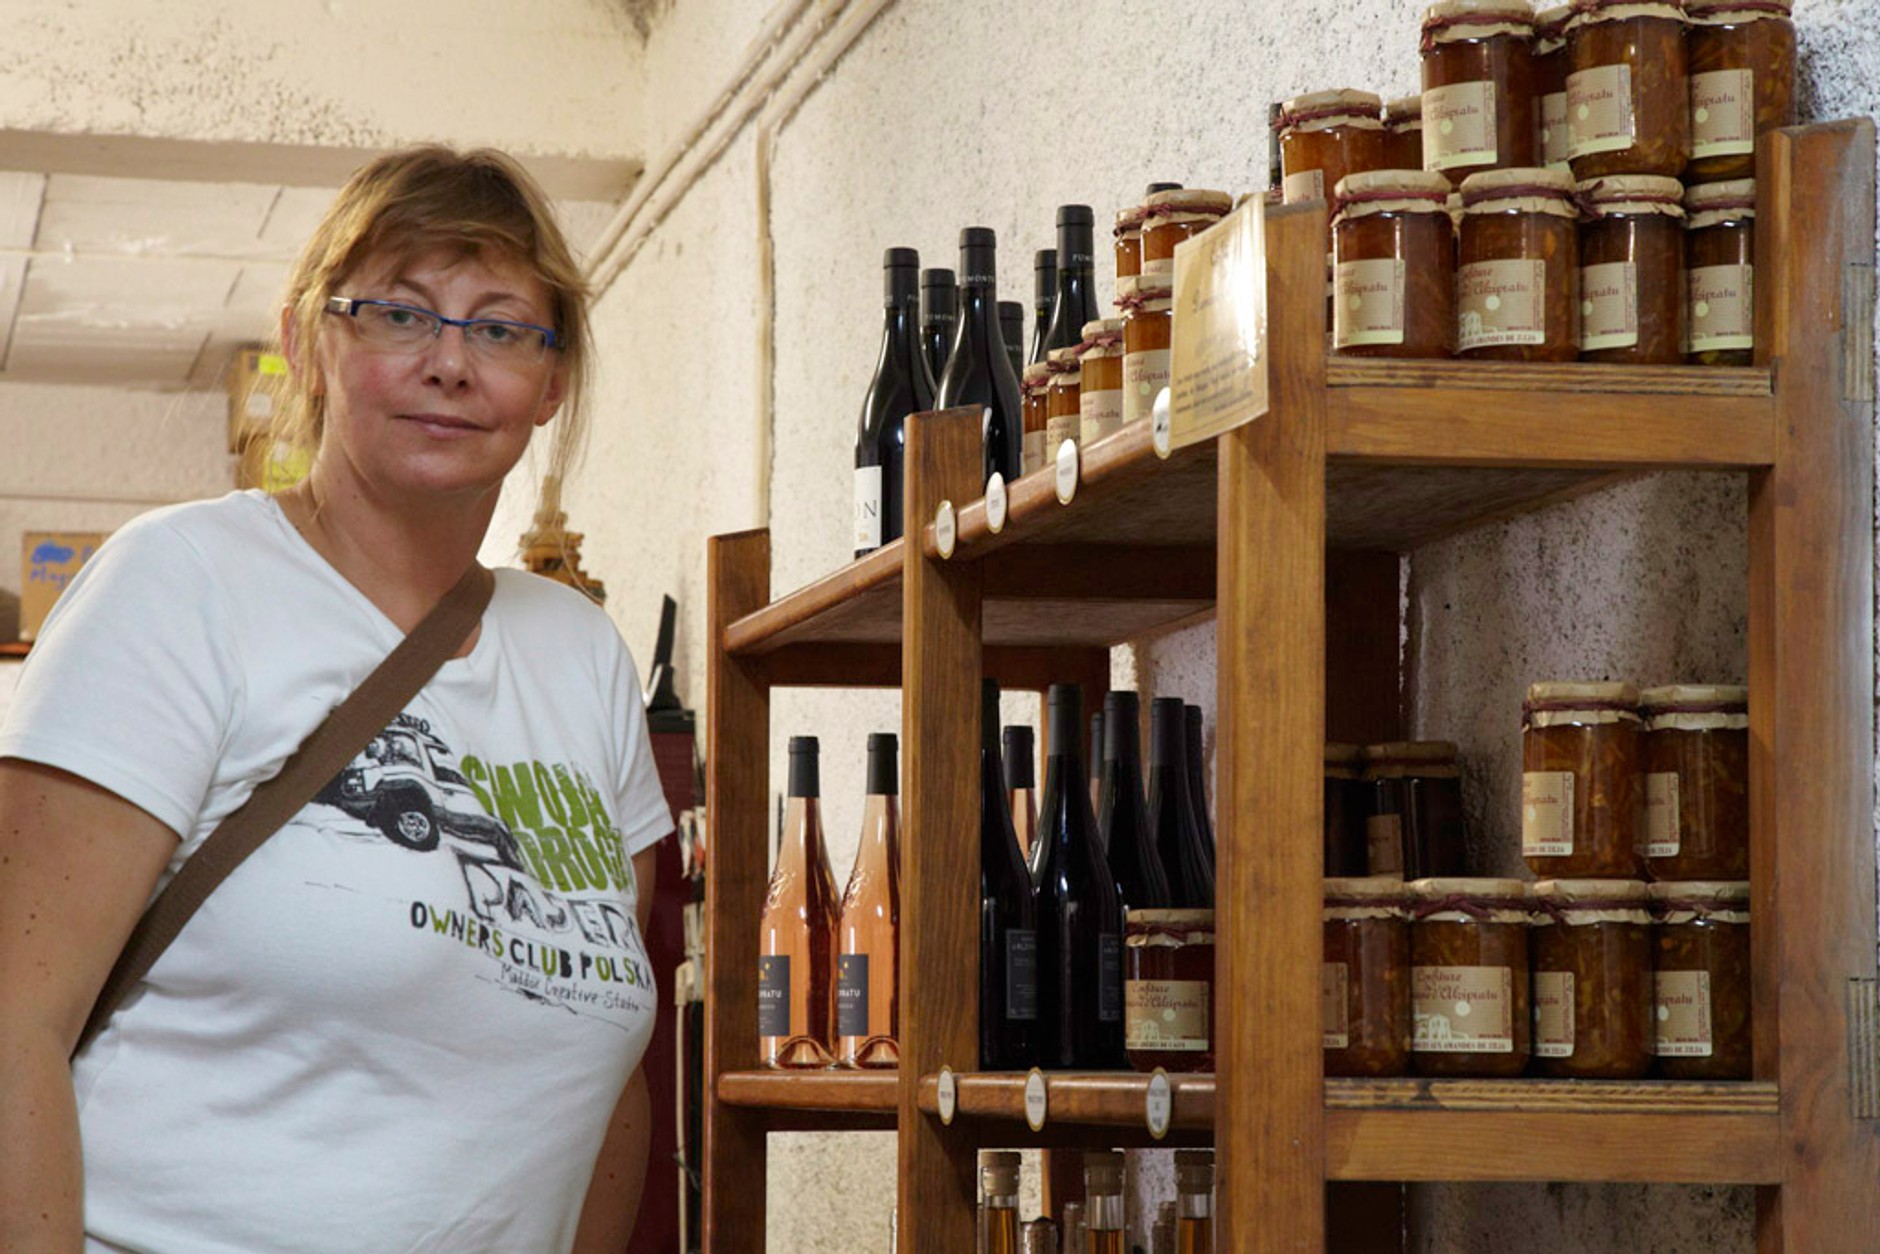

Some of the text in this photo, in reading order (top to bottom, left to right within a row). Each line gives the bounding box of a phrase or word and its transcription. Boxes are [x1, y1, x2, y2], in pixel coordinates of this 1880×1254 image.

[411, 901, 653, 993] OWNERS CLUB POLSKA
